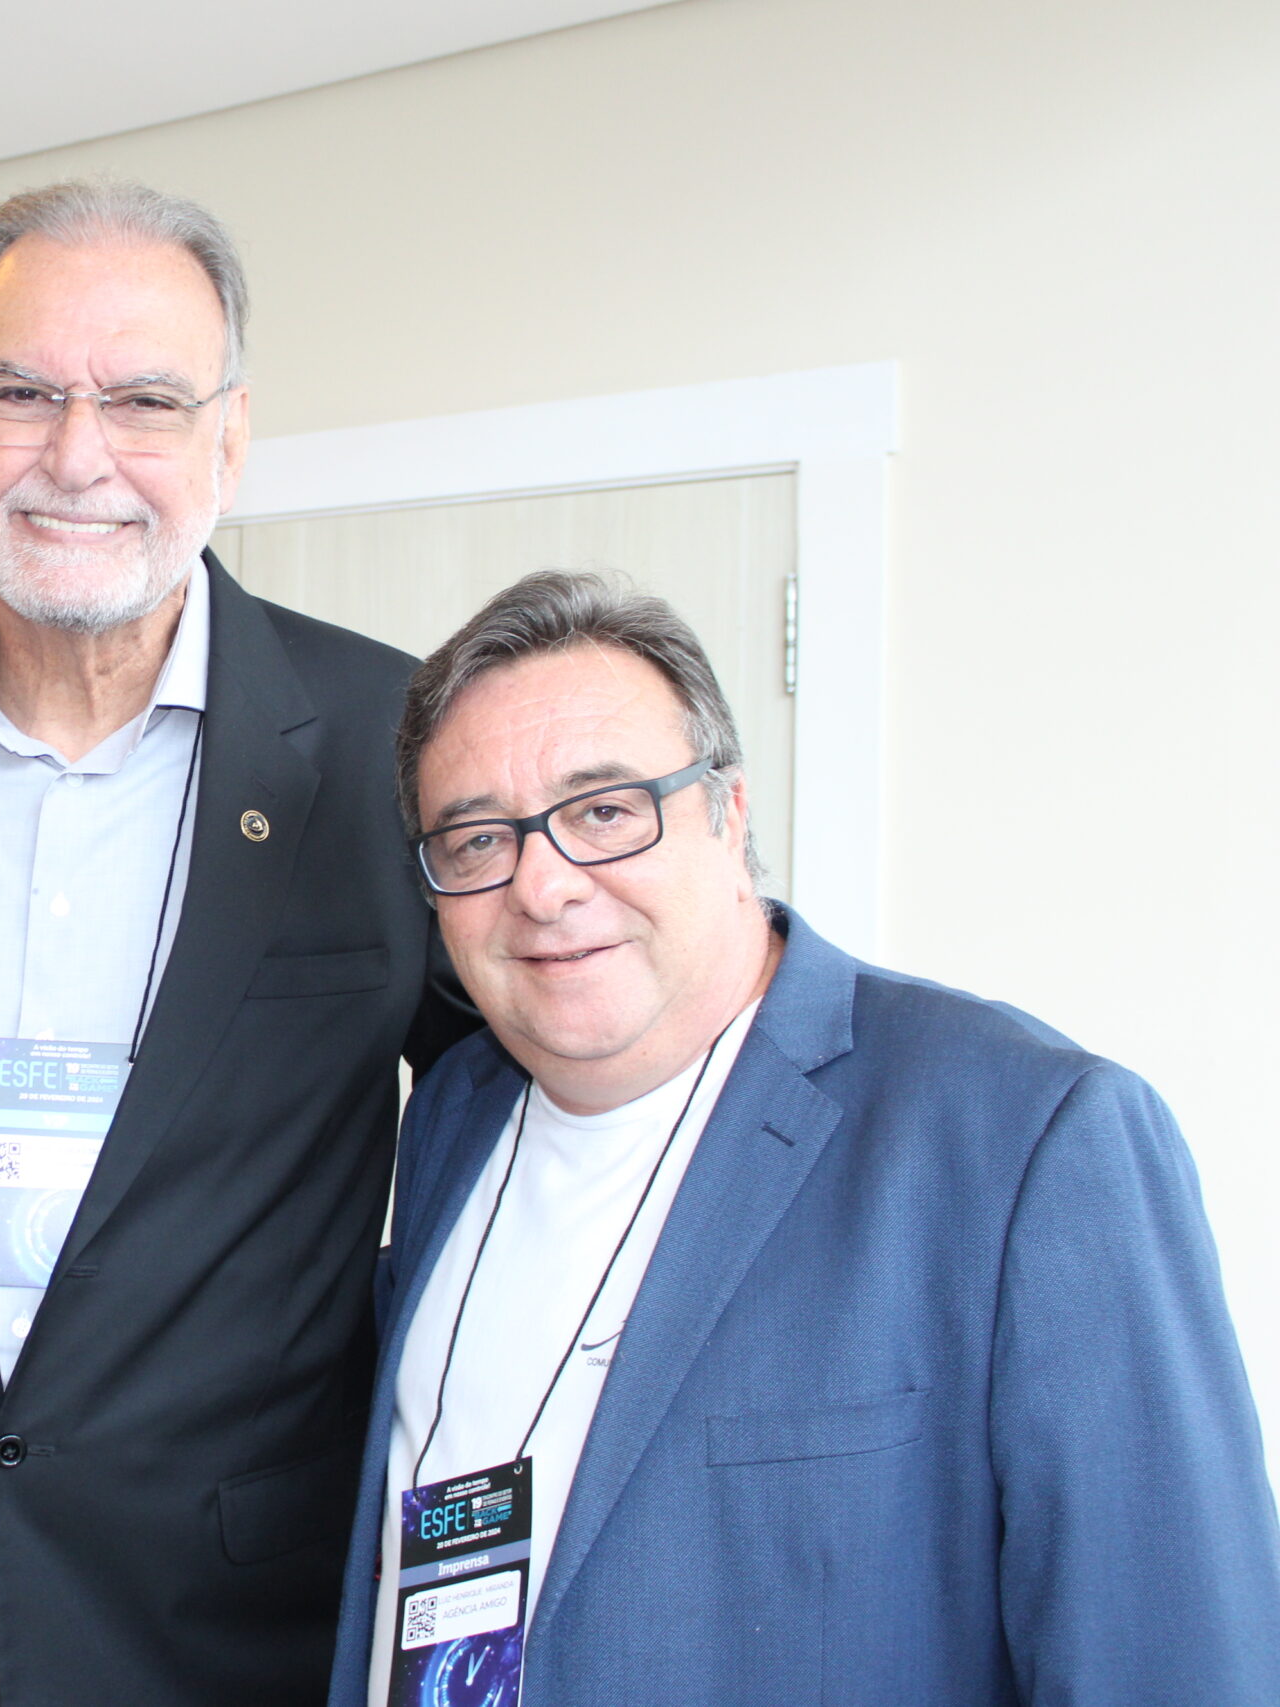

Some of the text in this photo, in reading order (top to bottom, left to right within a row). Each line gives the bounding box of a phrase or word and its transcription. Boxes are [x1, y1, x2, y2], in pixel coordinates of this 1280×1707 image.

[420, 1501, 466, 1540] ESFE
[438, 1555, 489, 1576] Imprensa
[443, 1596, 507, 1618] AGÊNCIA AMIGO
